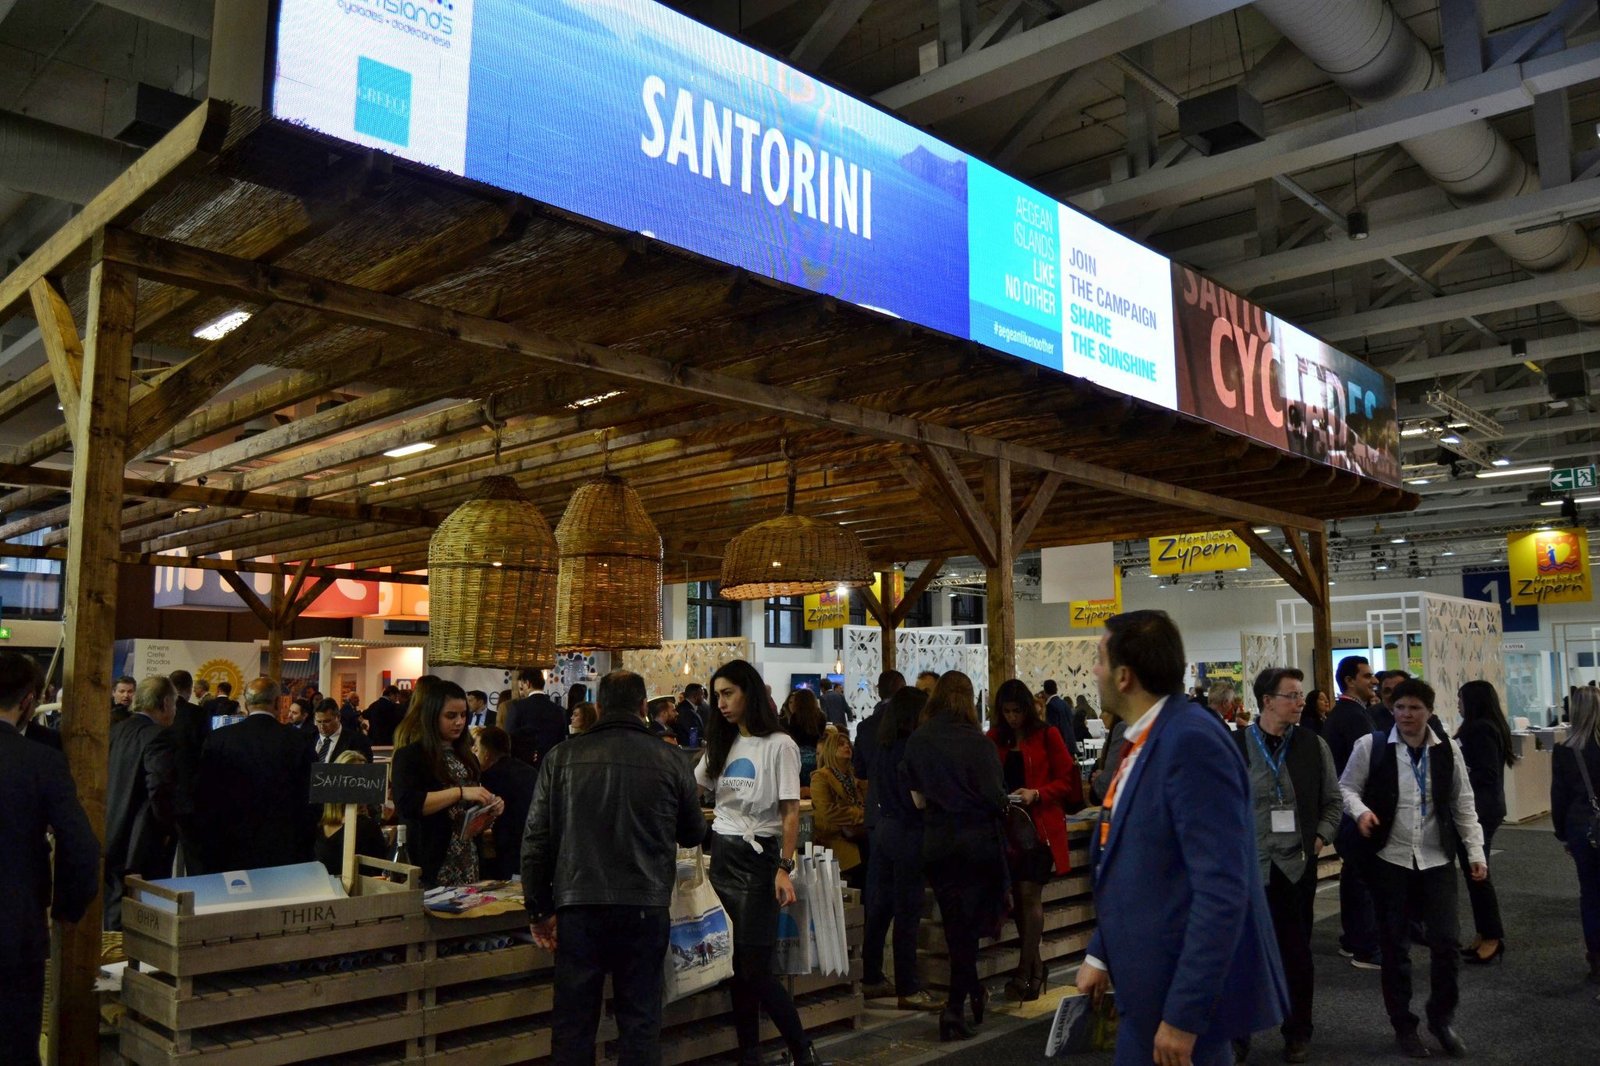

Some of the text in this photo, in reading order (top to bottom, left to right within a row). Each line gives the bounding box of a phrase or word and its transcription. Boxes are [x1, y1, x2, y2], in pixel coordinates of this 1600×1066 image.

[641, 75, 872, 240] SANTORINI
[1016, 195, 1054, 235] AEGEAN
[1014, 221, 1055, 262] ISLANDS
[1033, 258, 1056, 290] LIKE
[1069, 247, 1097, 277] JOIN
[1005, 273, 1056, 317] NO OTHER
[1069, 273, 1157, 330] THE CAMPAIGN
[1070, 302, 1112, 339] SHARE
[993, 320, 1054, 356] #aegeanlikenoother
[1071, 330, 1157, 383] THE SUNSHINE
[1158, 538, 1238, 570] Zypern
[1518, 578, 1583, 602] Zypern
[1074, 606, 1116, 626] Zypern
[211, 671, 229, 684] 25
[722, 779, 754, 789] SANTORINI
[281, 905, 336, 926] THIRA
